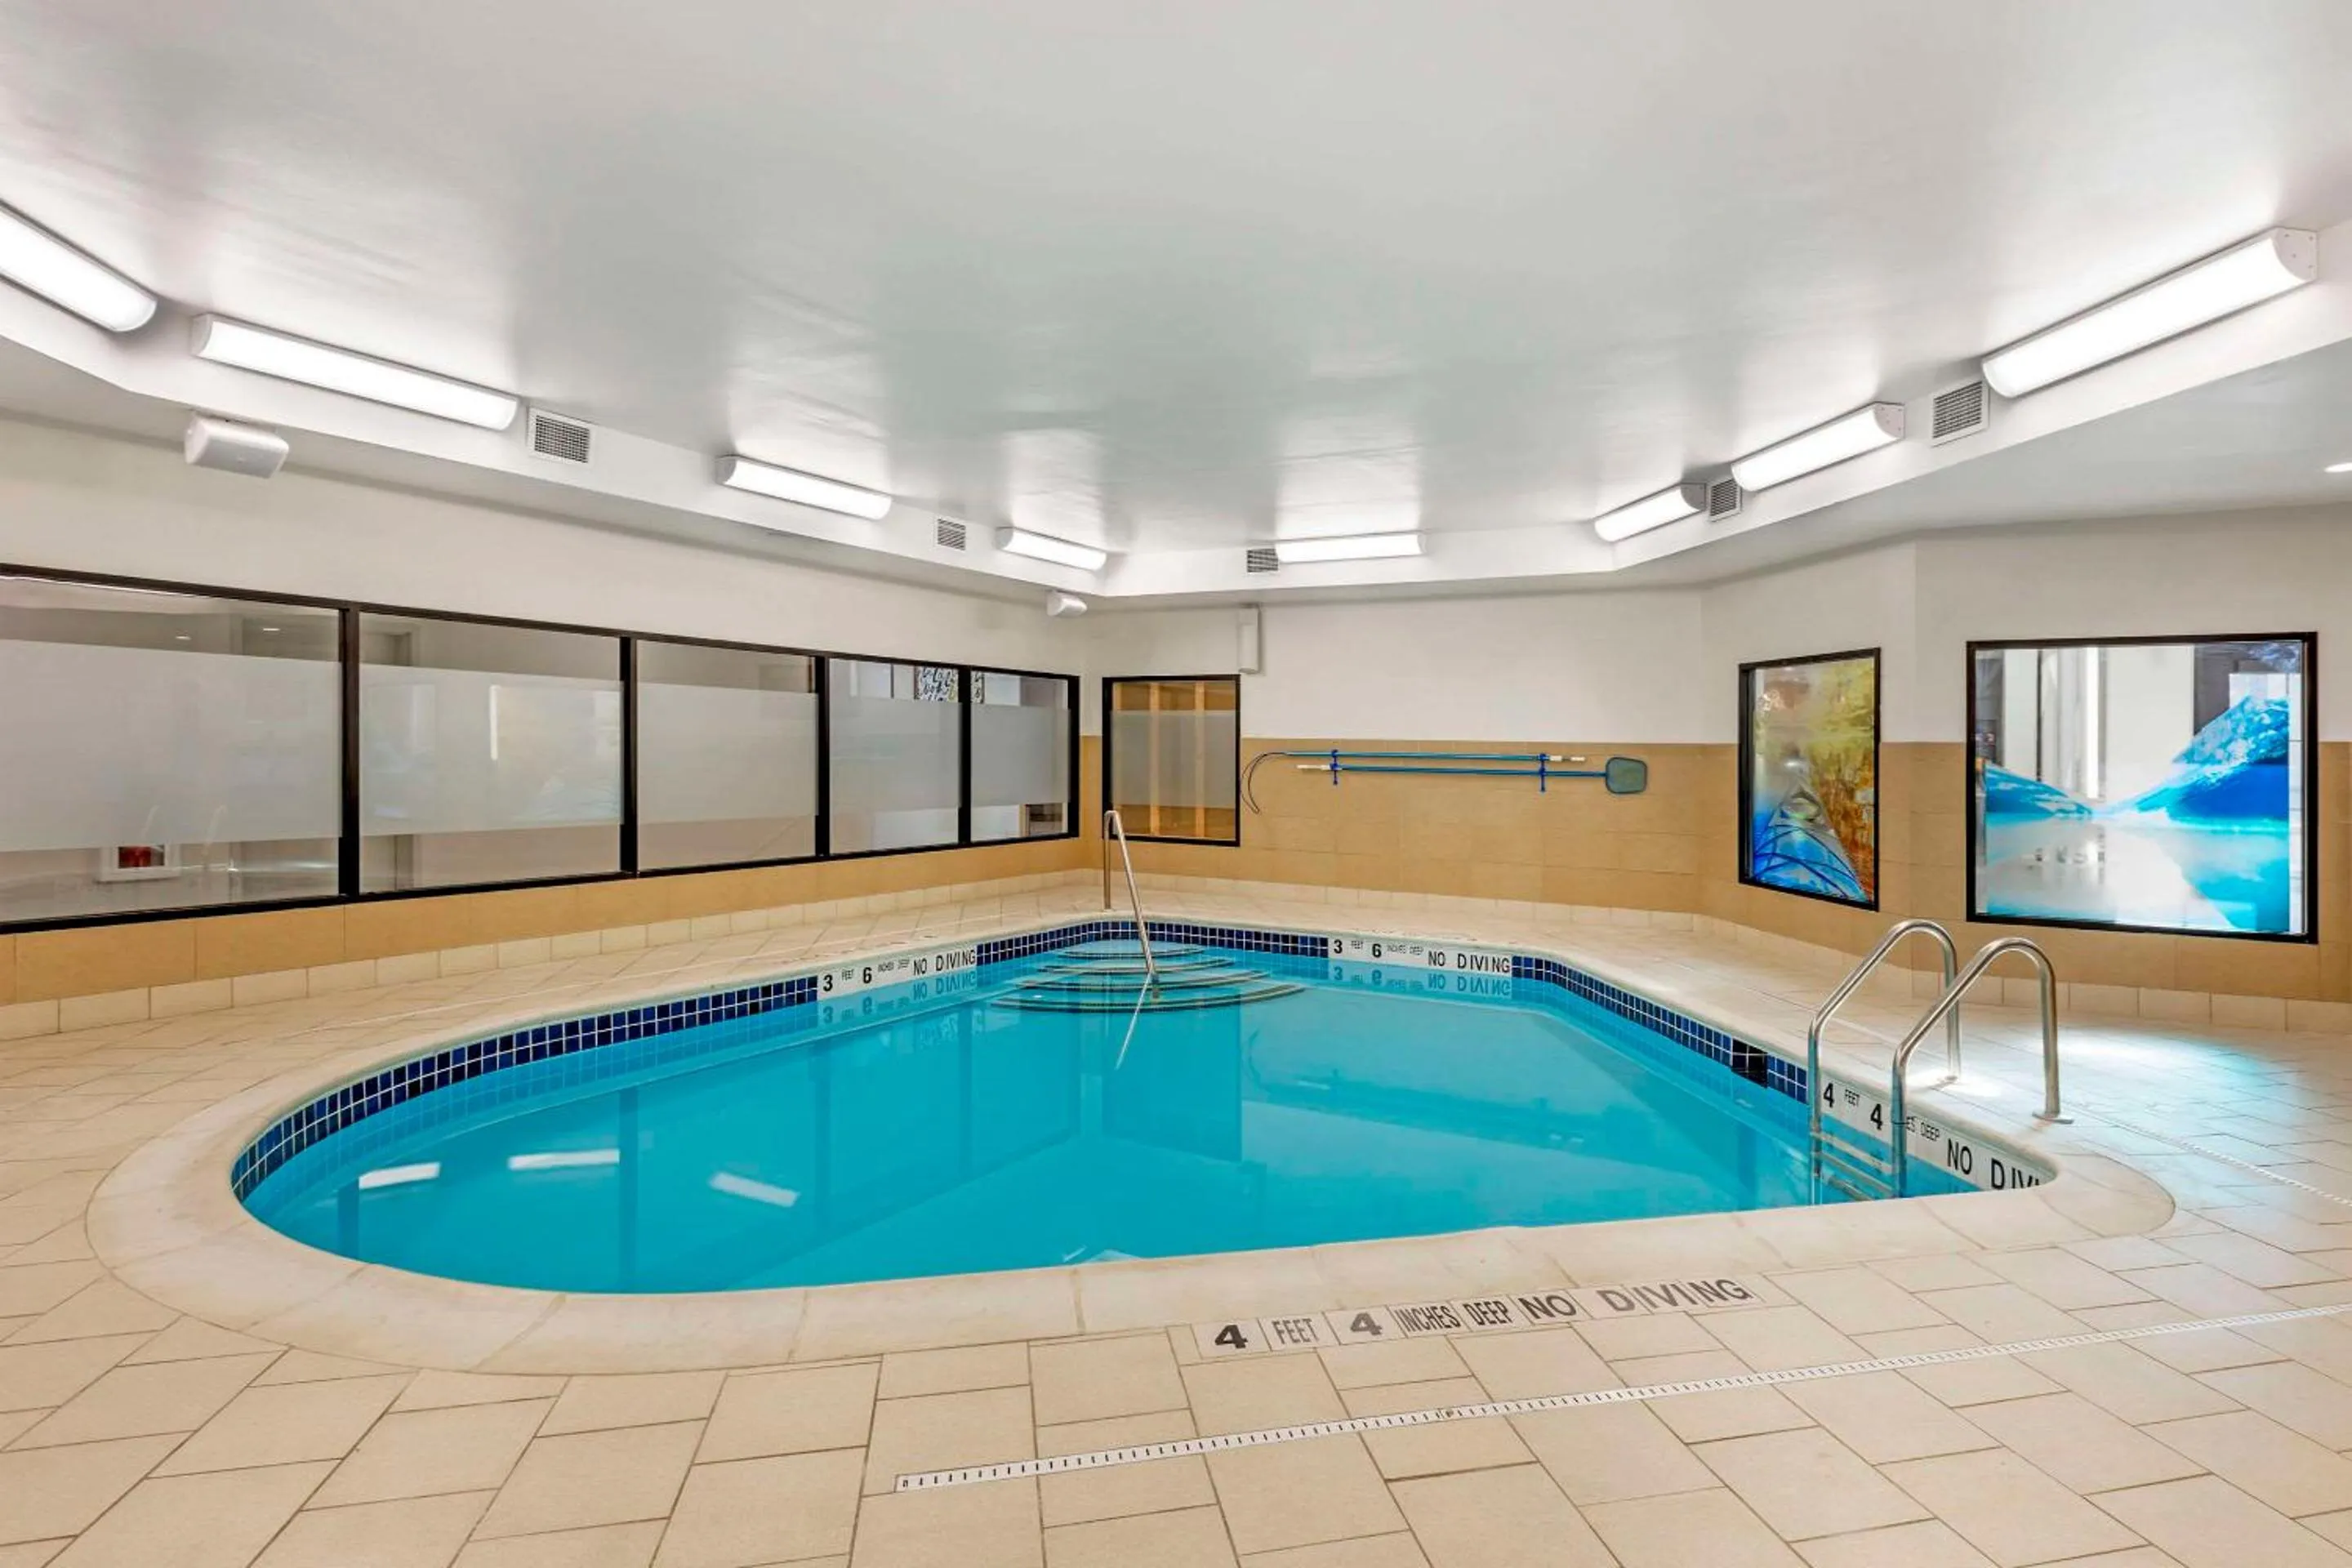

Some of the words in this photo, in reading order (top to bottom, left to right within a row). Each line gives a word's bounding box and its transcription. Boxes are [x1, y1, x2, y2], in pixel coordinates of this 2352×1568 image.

[823, 974, 833, 991] 3
[863, 967, 872, 984] 6
[914, 959, 928, 976] NO
[936, 949, 976, 971] DIVING
[1334, 939, 1343, 954] 3
[1372, 943, 1382, 958] 6
[1428, 951, 1446, 967] NO
[1458, 953, 1511, 973] DIVING
[1824, 1083, 1834, 1107] 4
[1845, 1089, 1860, 1107] FEET
[1870, 1103, 1882, 1130] 4
[1921, 1122, 1940, 1142] DEEP
[1948, 1138, 1971, 1174] NO
[1991, 1157, 2039, 1190] DIV
[1214, 1324, 1249, 1349] 4
[1272, 1318, 1320, 1344] FEET
[1350, 1312, 1383, 1336] 4
[1395, 1306, 1461, 1332] INCHES
[1463, 1300, 1512, 1326] DEEP
[1518, 1295, 1577, 1319] NO
[1596, 1279, 1753, 1312] DIVING
